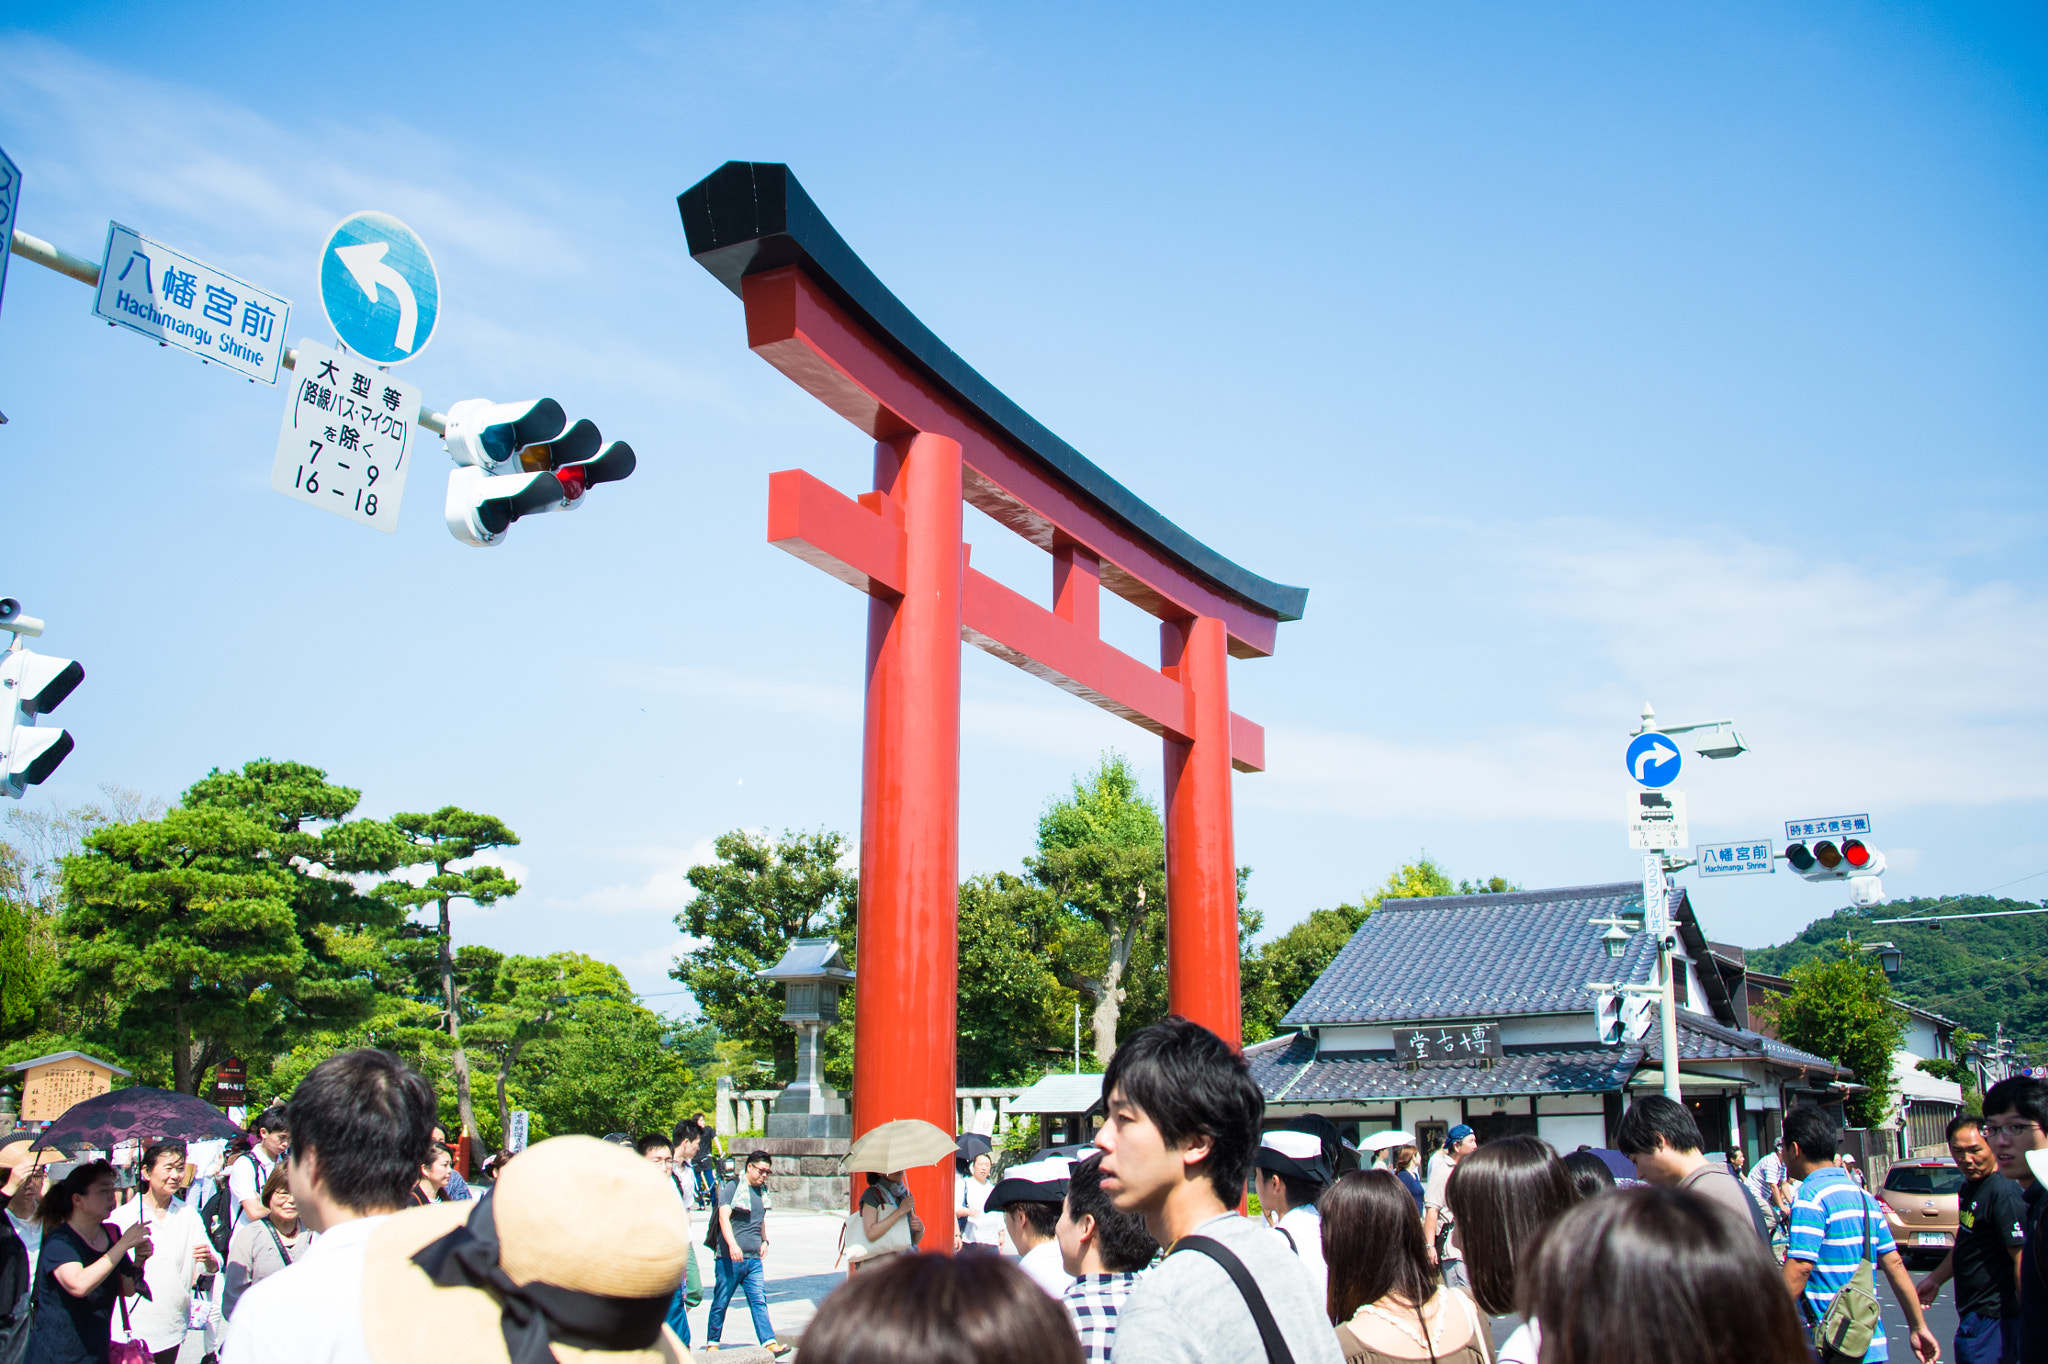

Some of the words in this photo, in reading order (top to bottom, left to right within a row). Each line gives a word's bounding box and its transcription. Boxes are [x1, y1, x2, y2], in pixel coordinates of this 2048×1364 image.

[118, 250, 276, 343] 八幡宮前
[115, 289, 212, 346] Hachimangu
[218, 332, 264, 367] Shrine
[323, 424, 374, 458] を除く
[1790, 818, 1866, 836] 時差式信号機
[1703, 845, 1767, 863] 八幡宮前
[1705, 864, 1744, 872] Hachimangu
[1746, 861, 1767, 870] Shrine
